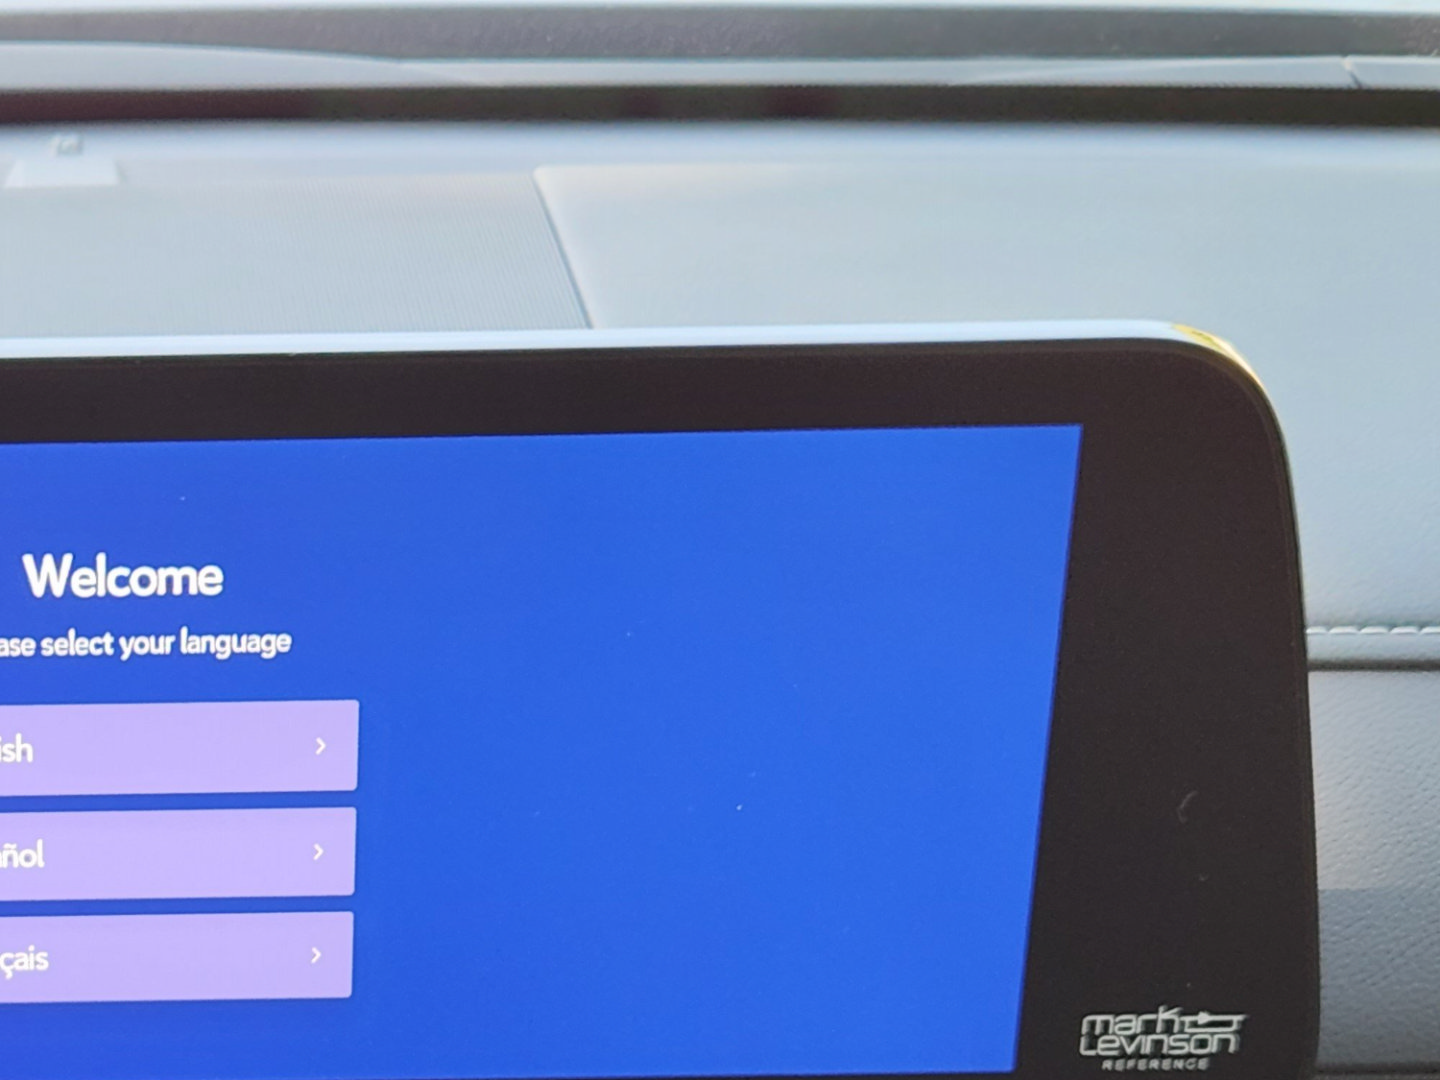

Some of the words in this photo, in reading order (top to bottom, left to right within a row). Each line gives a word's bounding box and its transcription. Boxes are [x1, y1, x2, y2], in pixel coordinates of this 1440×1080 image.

[22, 552, 224, 598] Welcome
[41, 628, 114, 657] select
[120, 632, 174, 661] your
[180, 627, 292, 659] language
[1079, 1033, 1240, 1056] Levinson
[1101, 1057, 1210, 1071] REFERENCE
